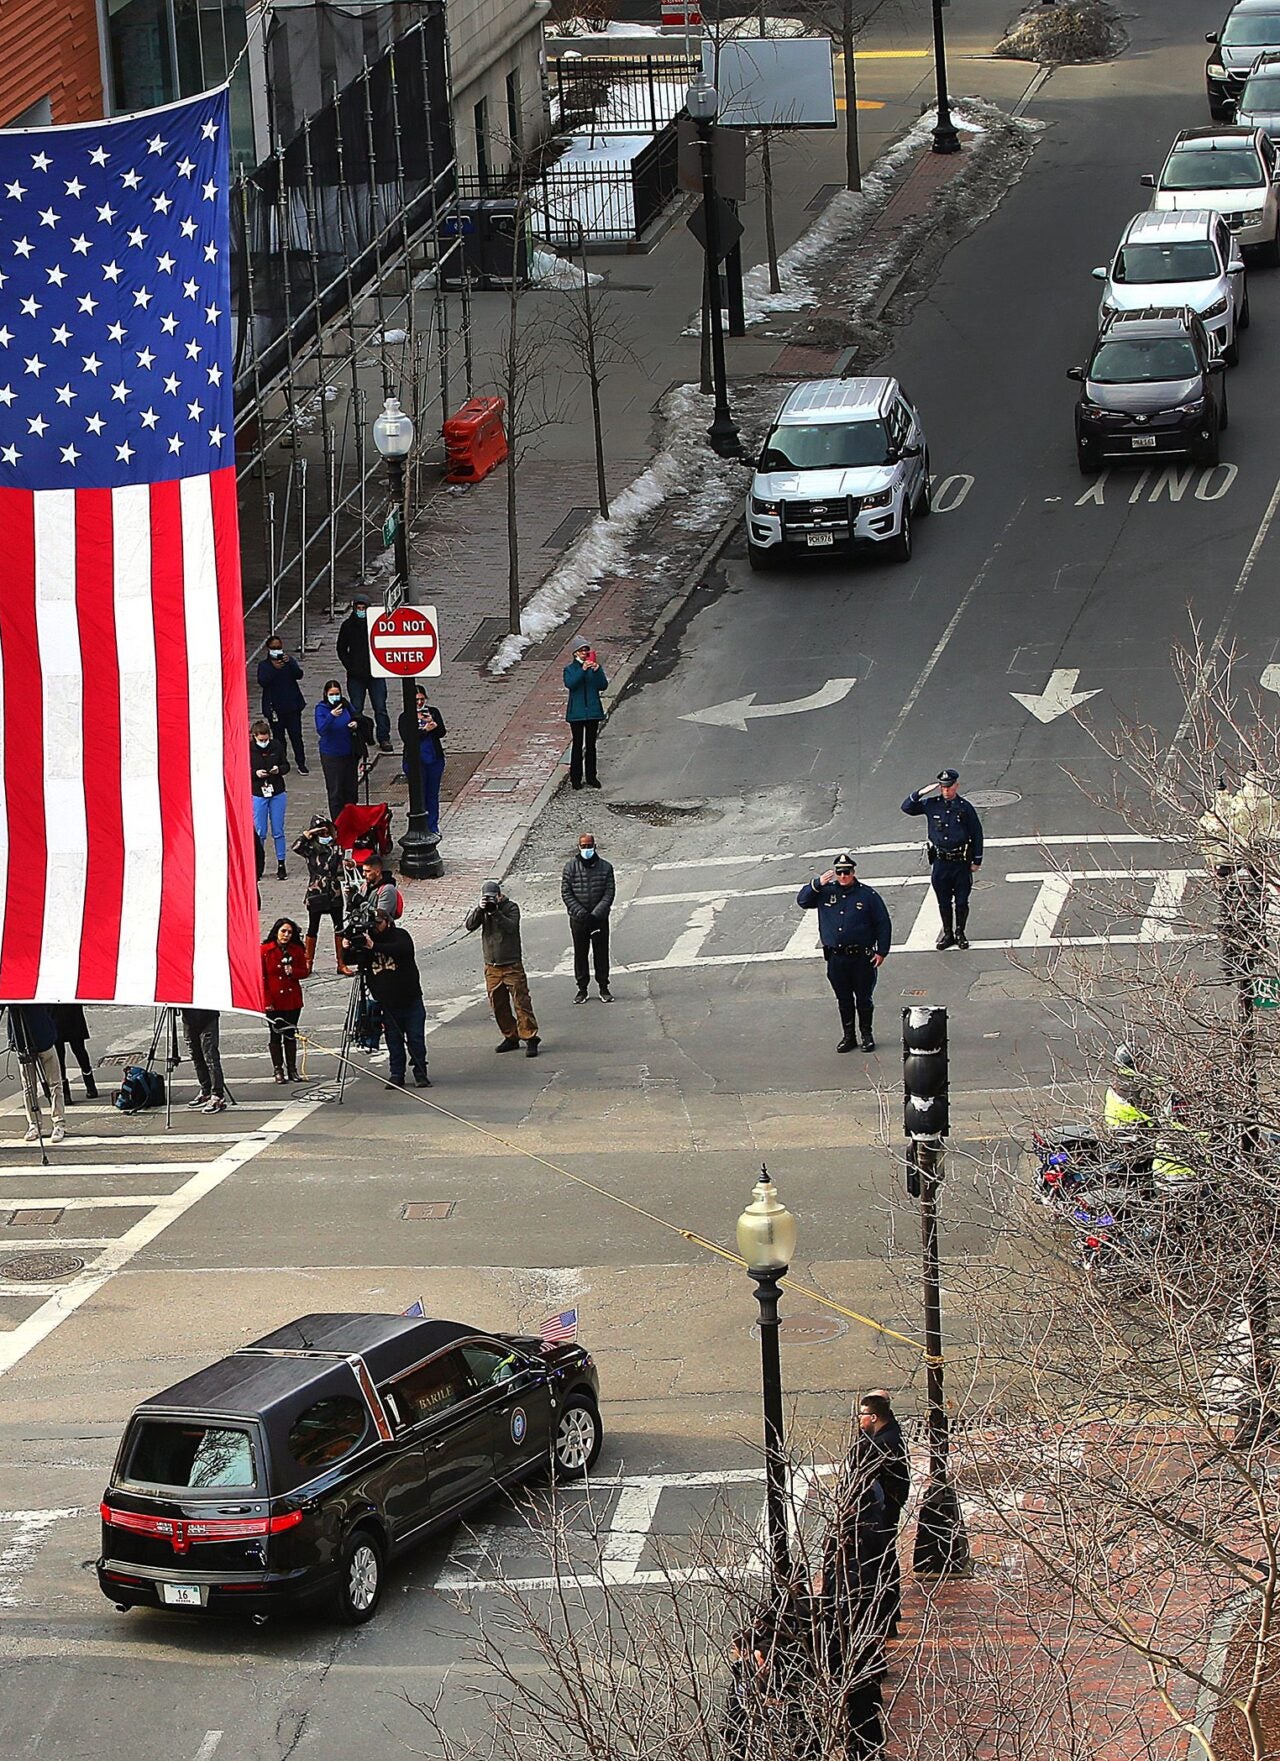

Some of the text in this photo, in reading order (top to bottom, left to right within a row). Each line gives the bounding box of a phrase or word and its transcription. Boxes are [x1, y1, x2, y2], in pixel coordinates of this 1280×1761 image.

[378, 620, 426, 633] DO NOT
[385, 651, 425, 663] ENTER
[418, 1385, 452, 1410] BARILE
[177, 1589, 188, 1600] 16
